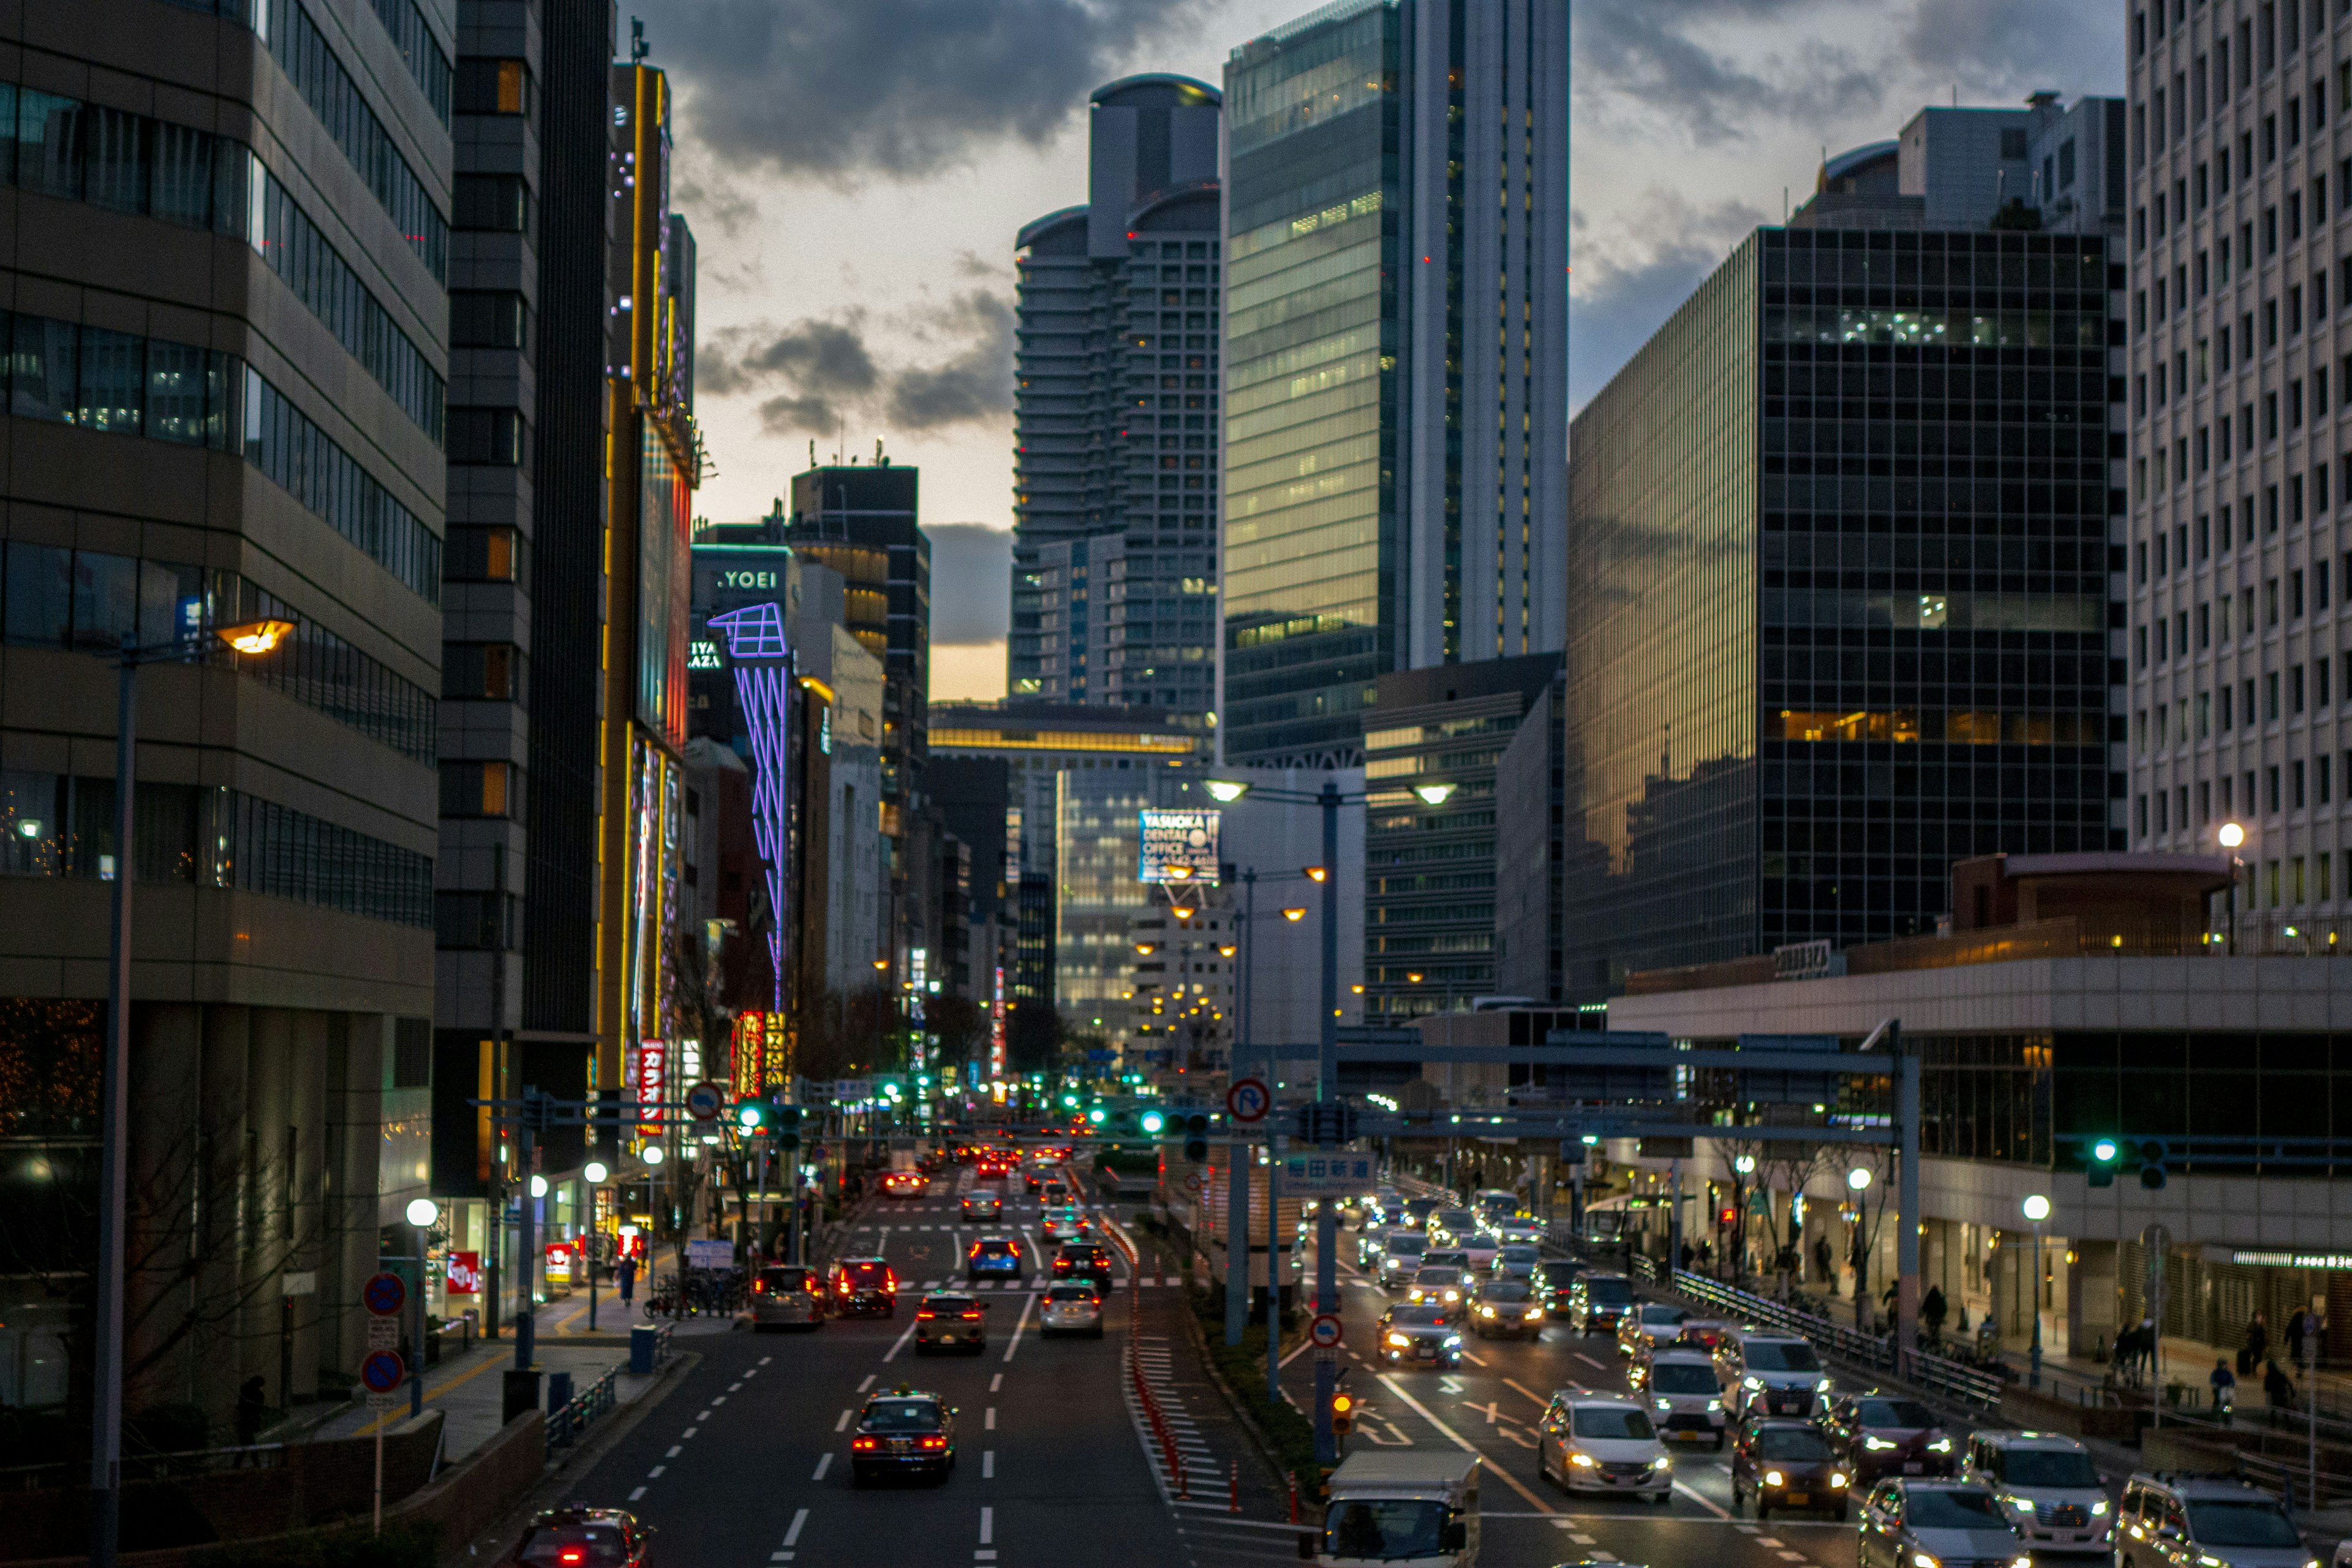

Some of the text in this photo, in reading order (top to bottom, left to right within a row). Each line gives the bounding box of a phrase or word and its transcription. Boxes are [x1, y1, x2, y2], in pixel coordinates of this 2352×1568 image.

[1144, 815, 1205, 828] YASUOKA
[1144, 829, 1188, 841] DENTAL
[1143, 842, 1185, 854] OFFICE
